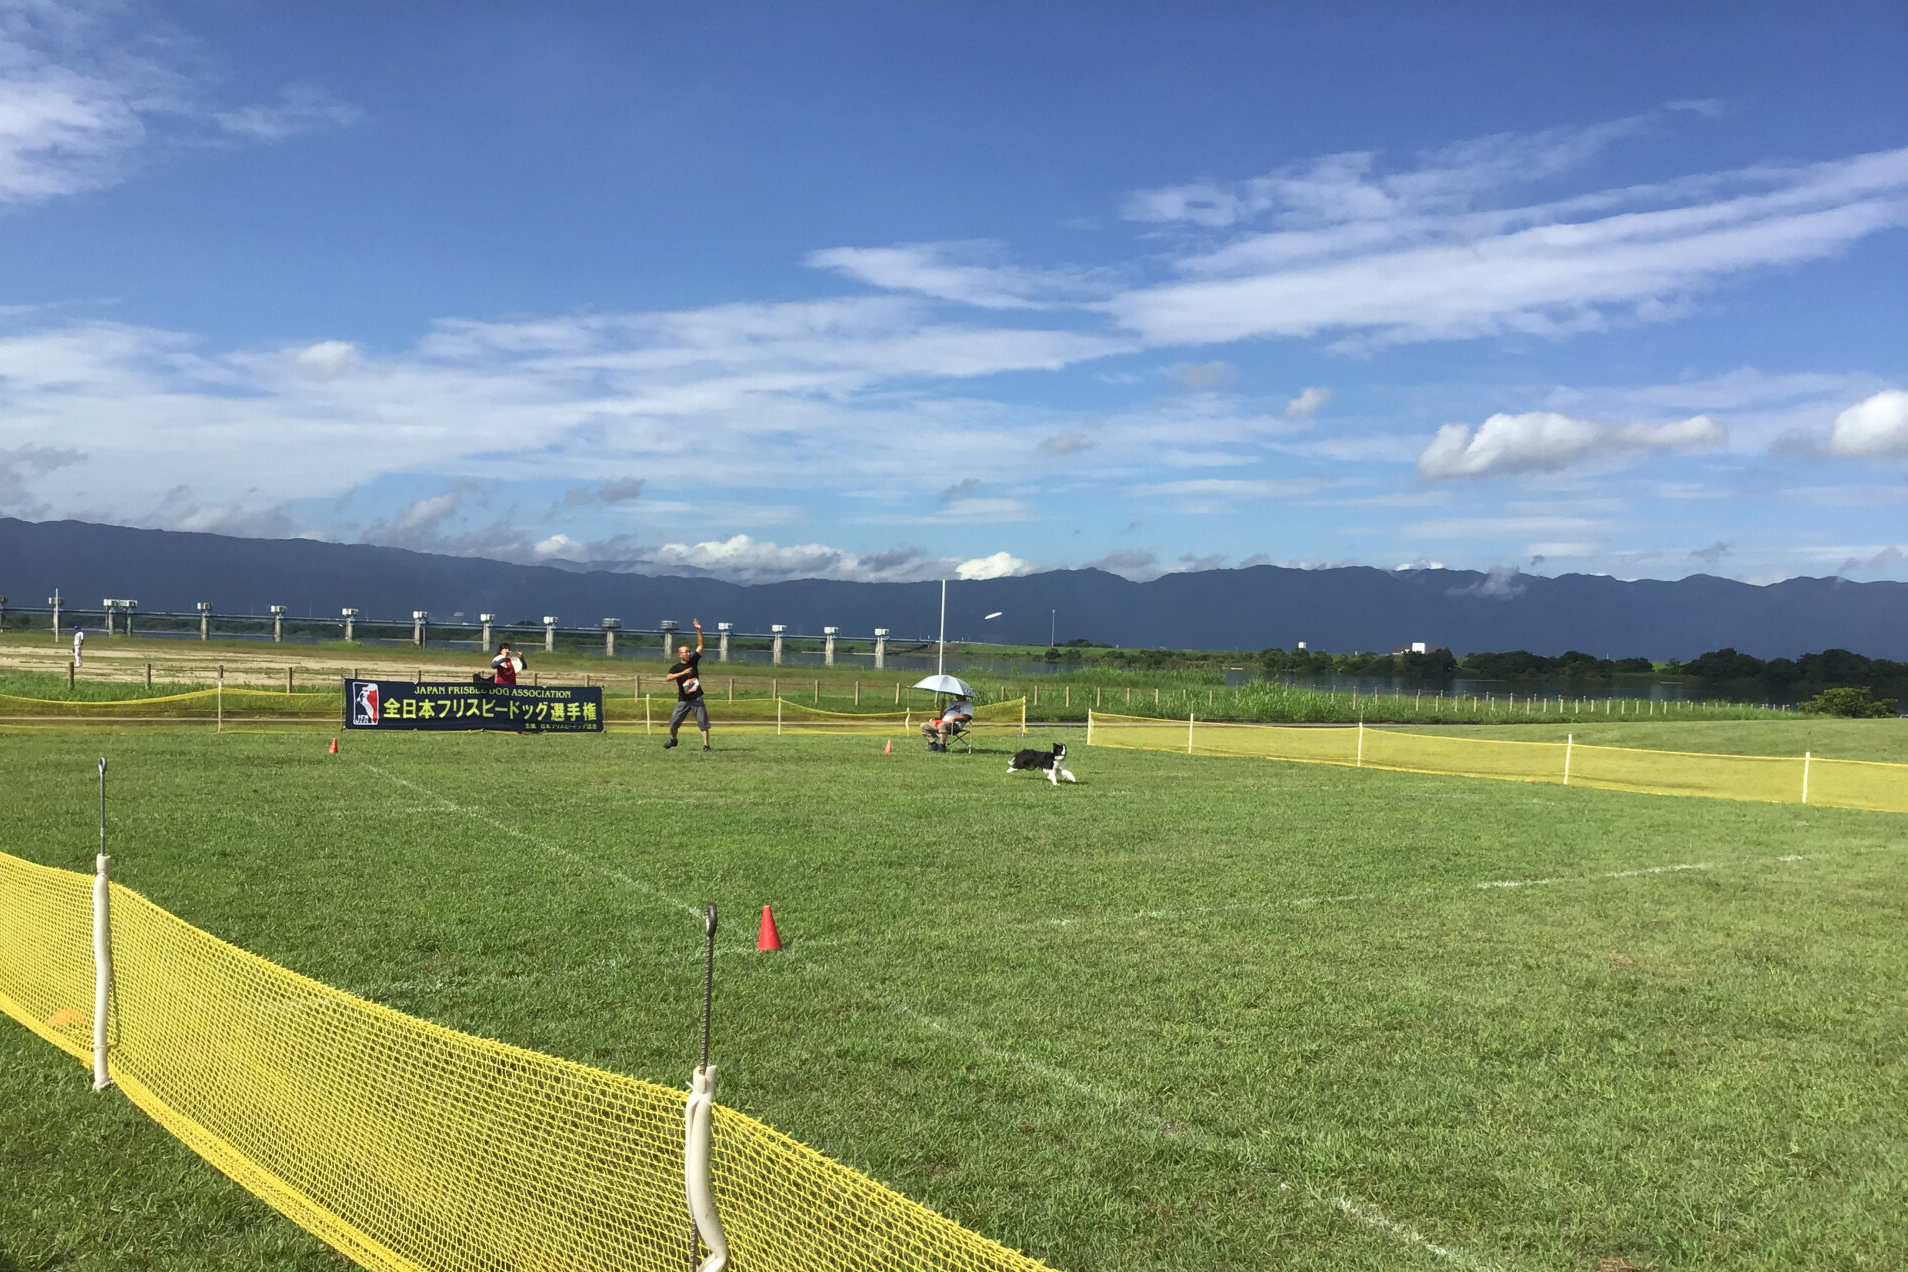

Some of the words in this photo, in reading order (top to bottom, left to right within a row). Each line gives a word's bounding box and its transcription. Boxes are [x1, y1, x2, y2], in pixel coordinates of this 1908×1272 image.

[414, 686, 446, 695] JAPAN
[489, 687, 510, 696] DOG
[511, 688, 571, 698] ASSOCIATION
[383, 697, 597, 722] 全日本フリスビードッグ選手権
[355, 714, 369, 723] JFA
